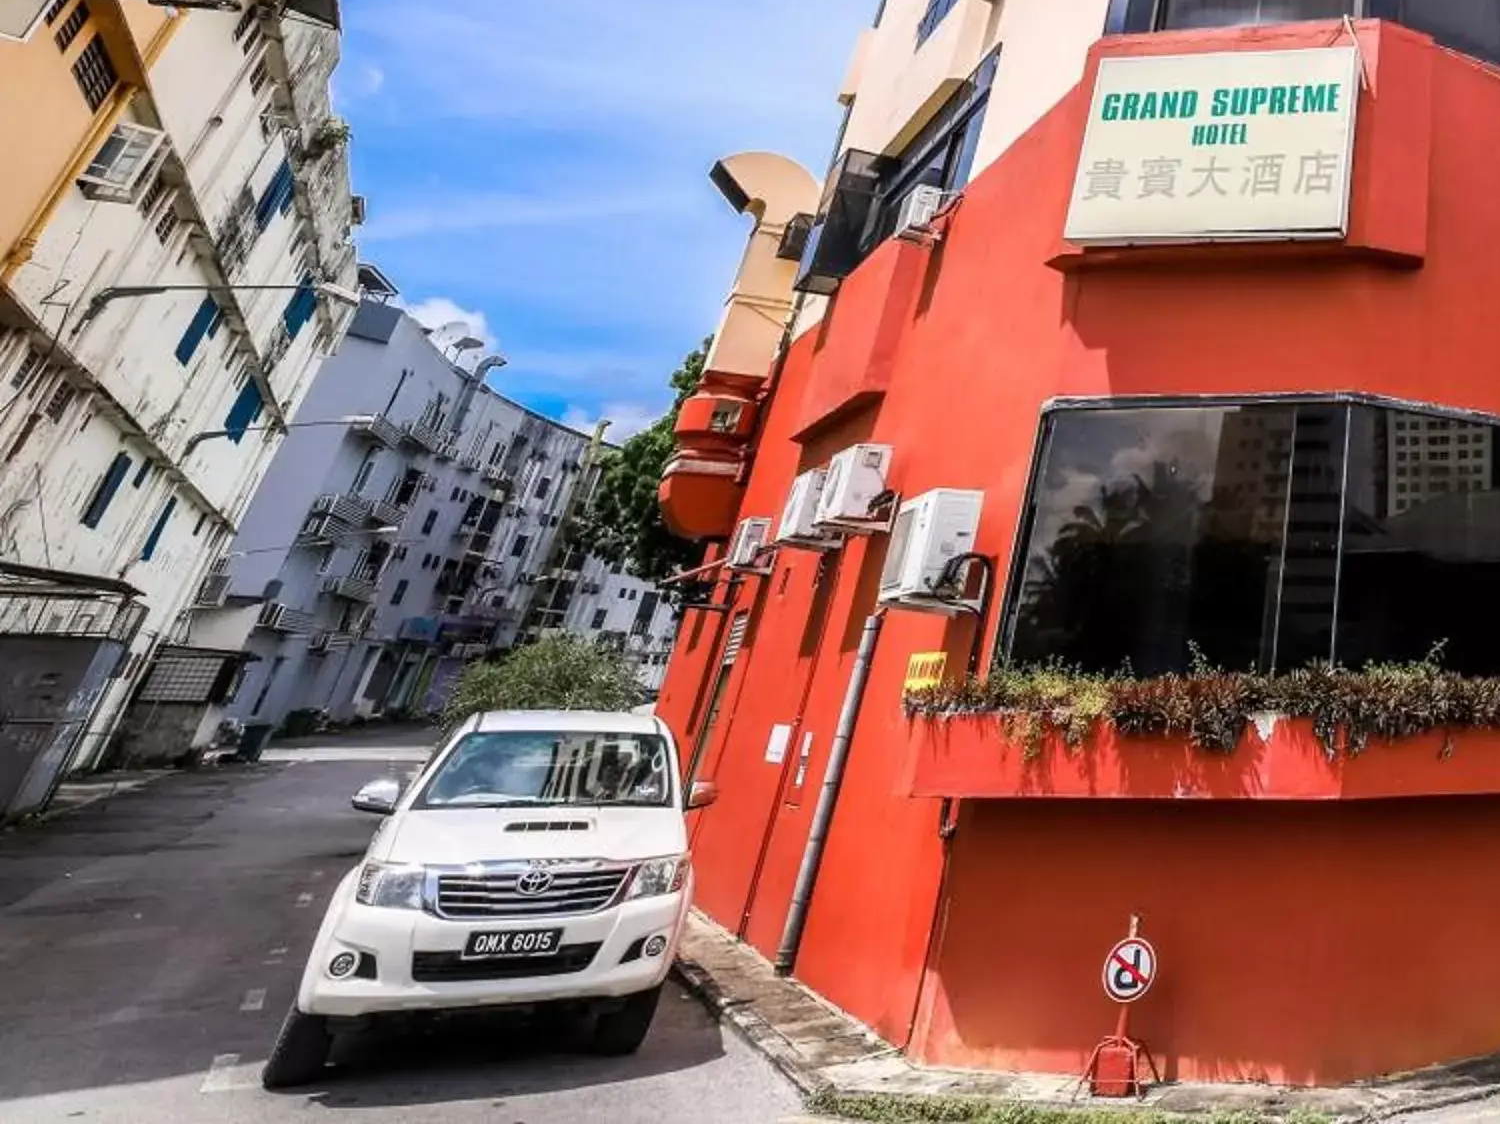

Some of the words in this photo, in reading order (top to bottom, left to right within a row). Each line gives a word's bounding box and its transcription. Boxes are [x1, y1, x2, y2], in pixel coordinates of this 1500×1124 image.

[1101, 90, 1199, 121] GRAND
[1210, 83, 1341, 117] SUPREME
[1191, 123, 1248, 146] HOTEL
[1081, 149, 1340, 201] 貴賓大酒店
[511, 931, 554, 952] 6015
